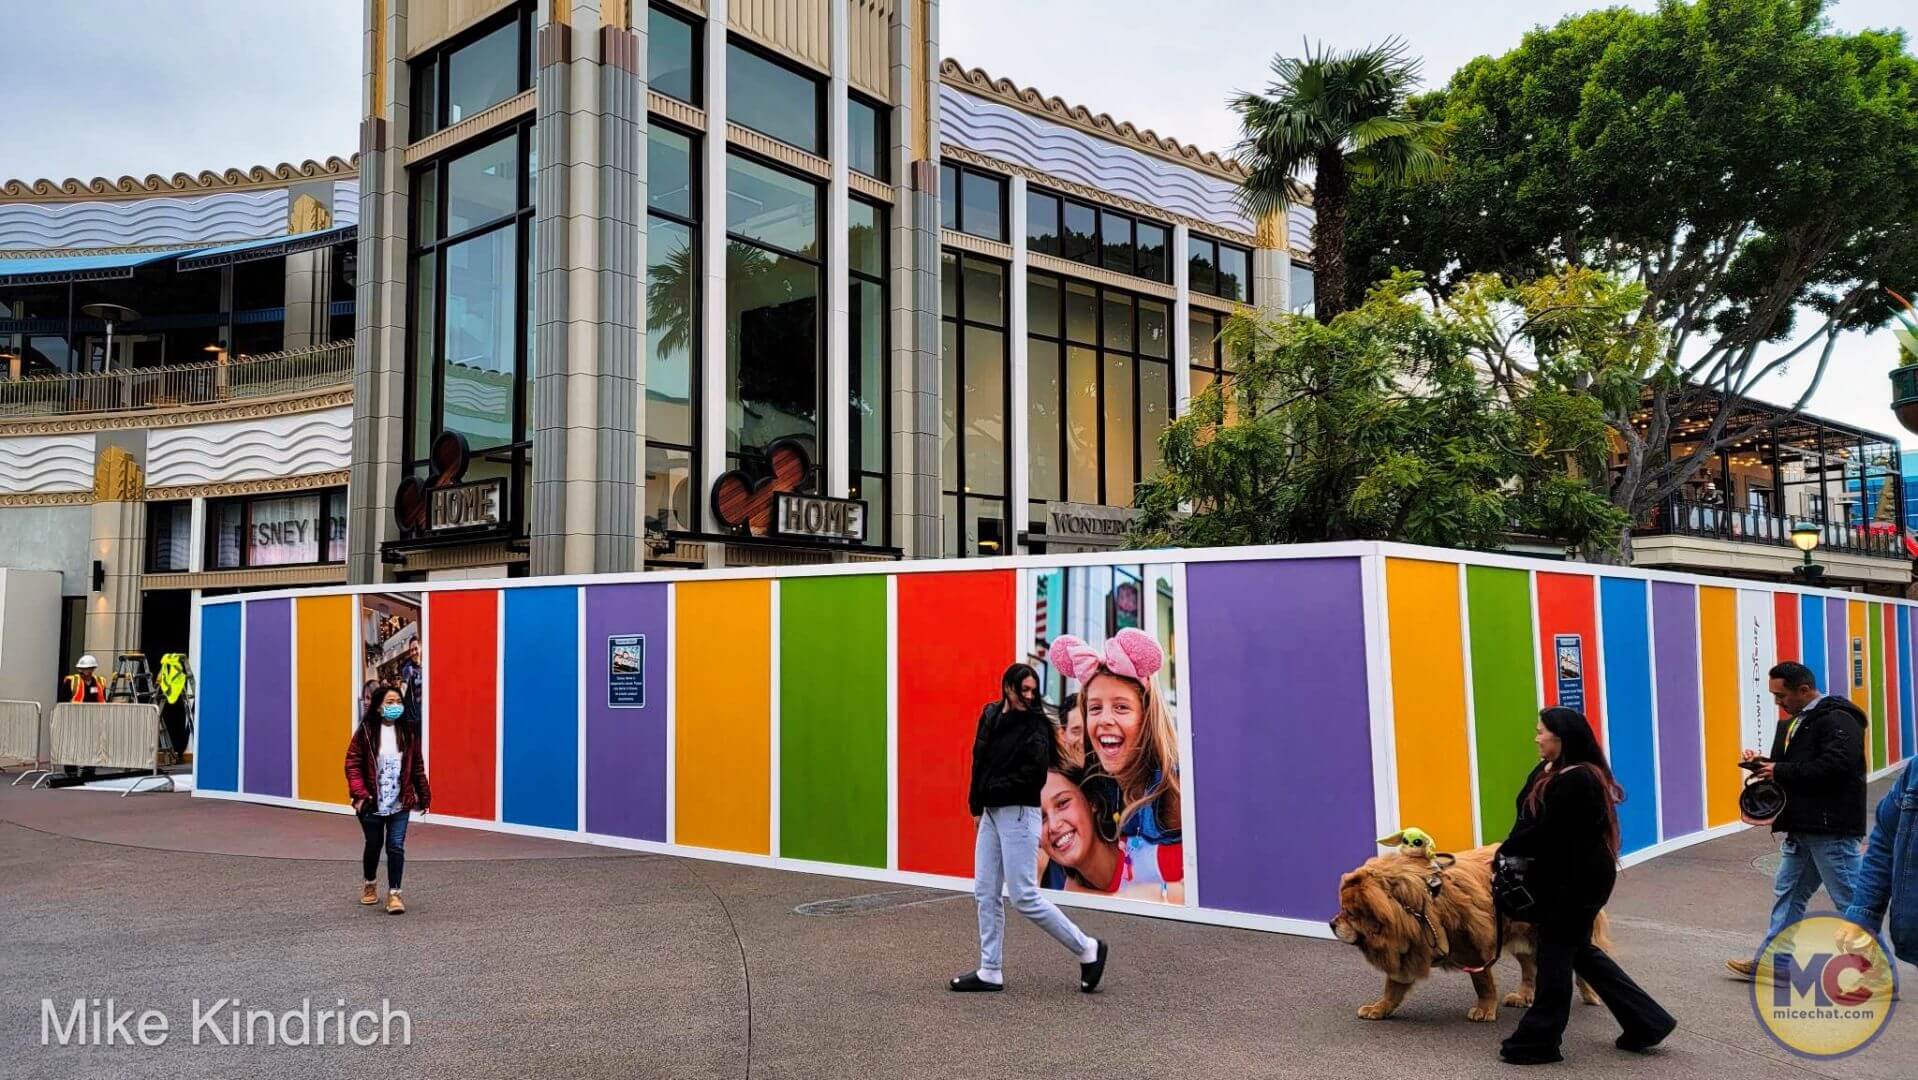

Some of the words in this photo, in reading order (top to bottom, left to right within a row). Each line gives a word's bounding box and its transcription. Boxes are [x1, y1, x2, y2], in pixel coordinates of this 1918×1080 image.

[431, 484, 497, 526] HOME
[784, 496, 860, 536] HOME
[1052, 511, 1137, 536] WONDERG
